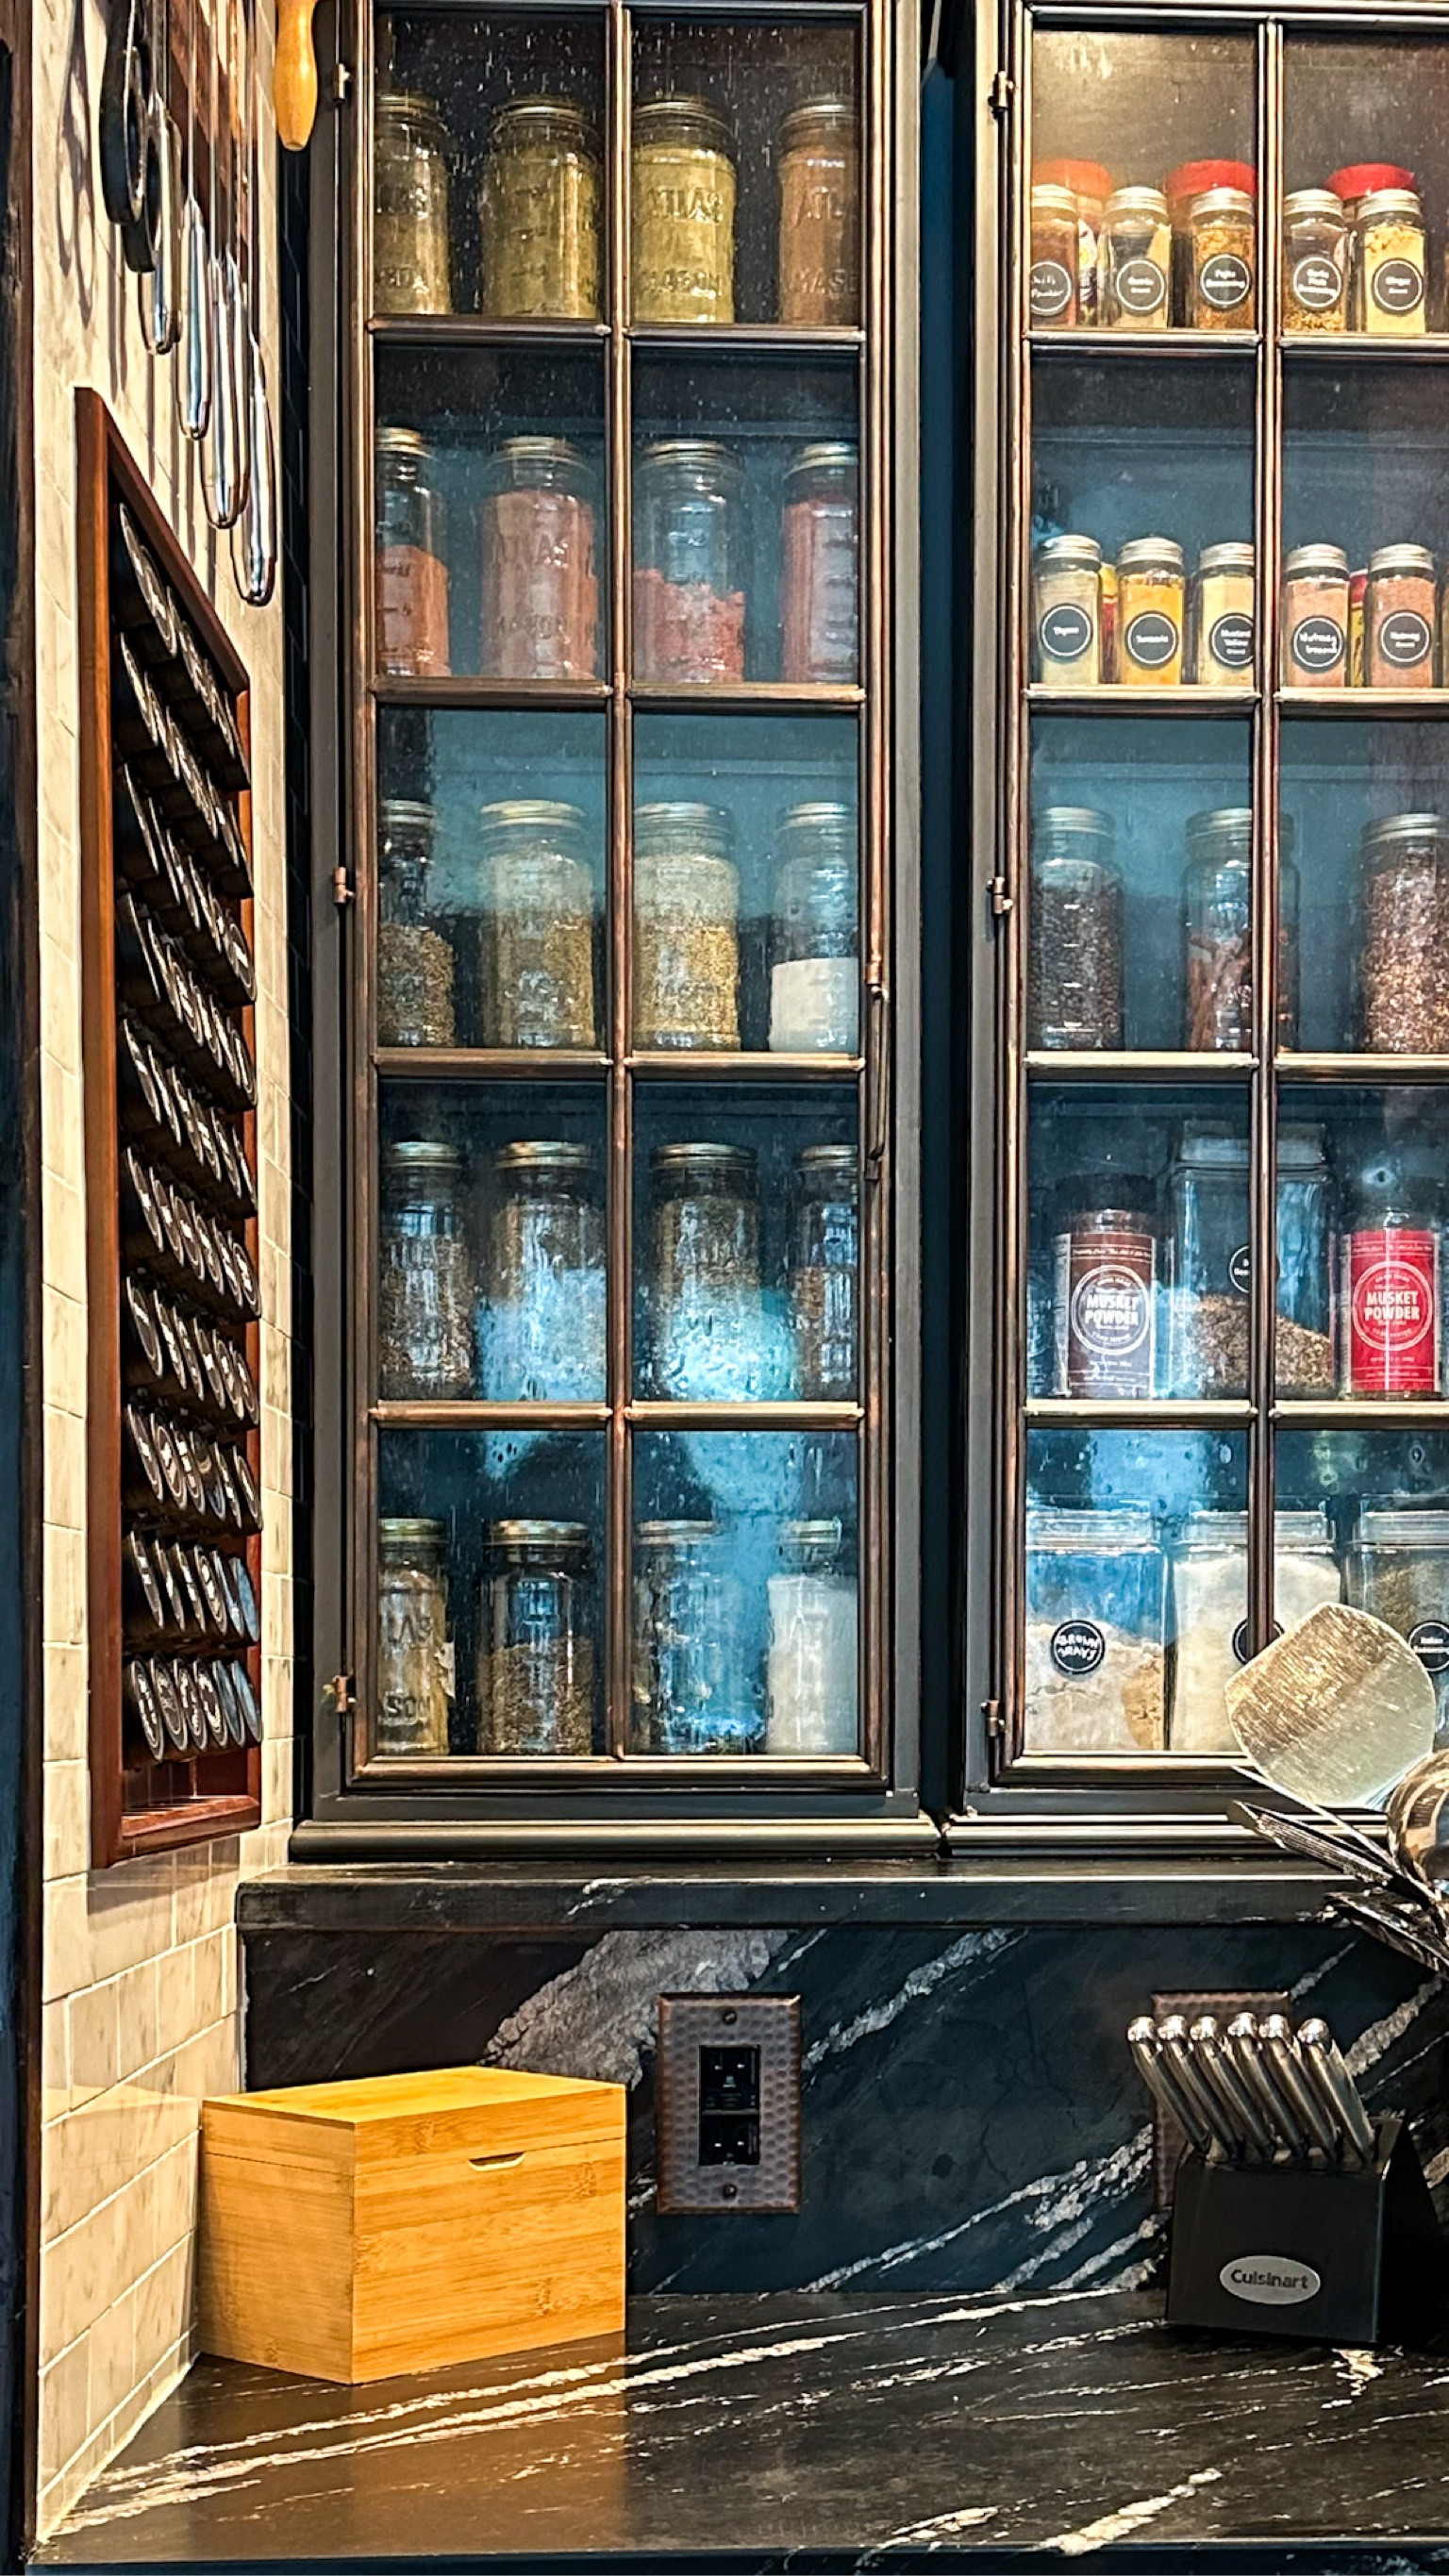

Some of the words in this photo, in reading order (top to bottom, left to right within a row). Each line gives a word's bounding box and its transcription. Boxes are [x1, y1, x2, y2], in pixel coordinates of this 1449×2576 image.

[1086, 1294, 1139, 1309] MUSKET
[1366, 1290, 1418, 1305] MUSKET
[1084, 1310, 1139, 1325] POWDER
[1364, 1306, 1420, 1321] POWDER
[1231, 2269, 1308, 2289] Cuisinart
